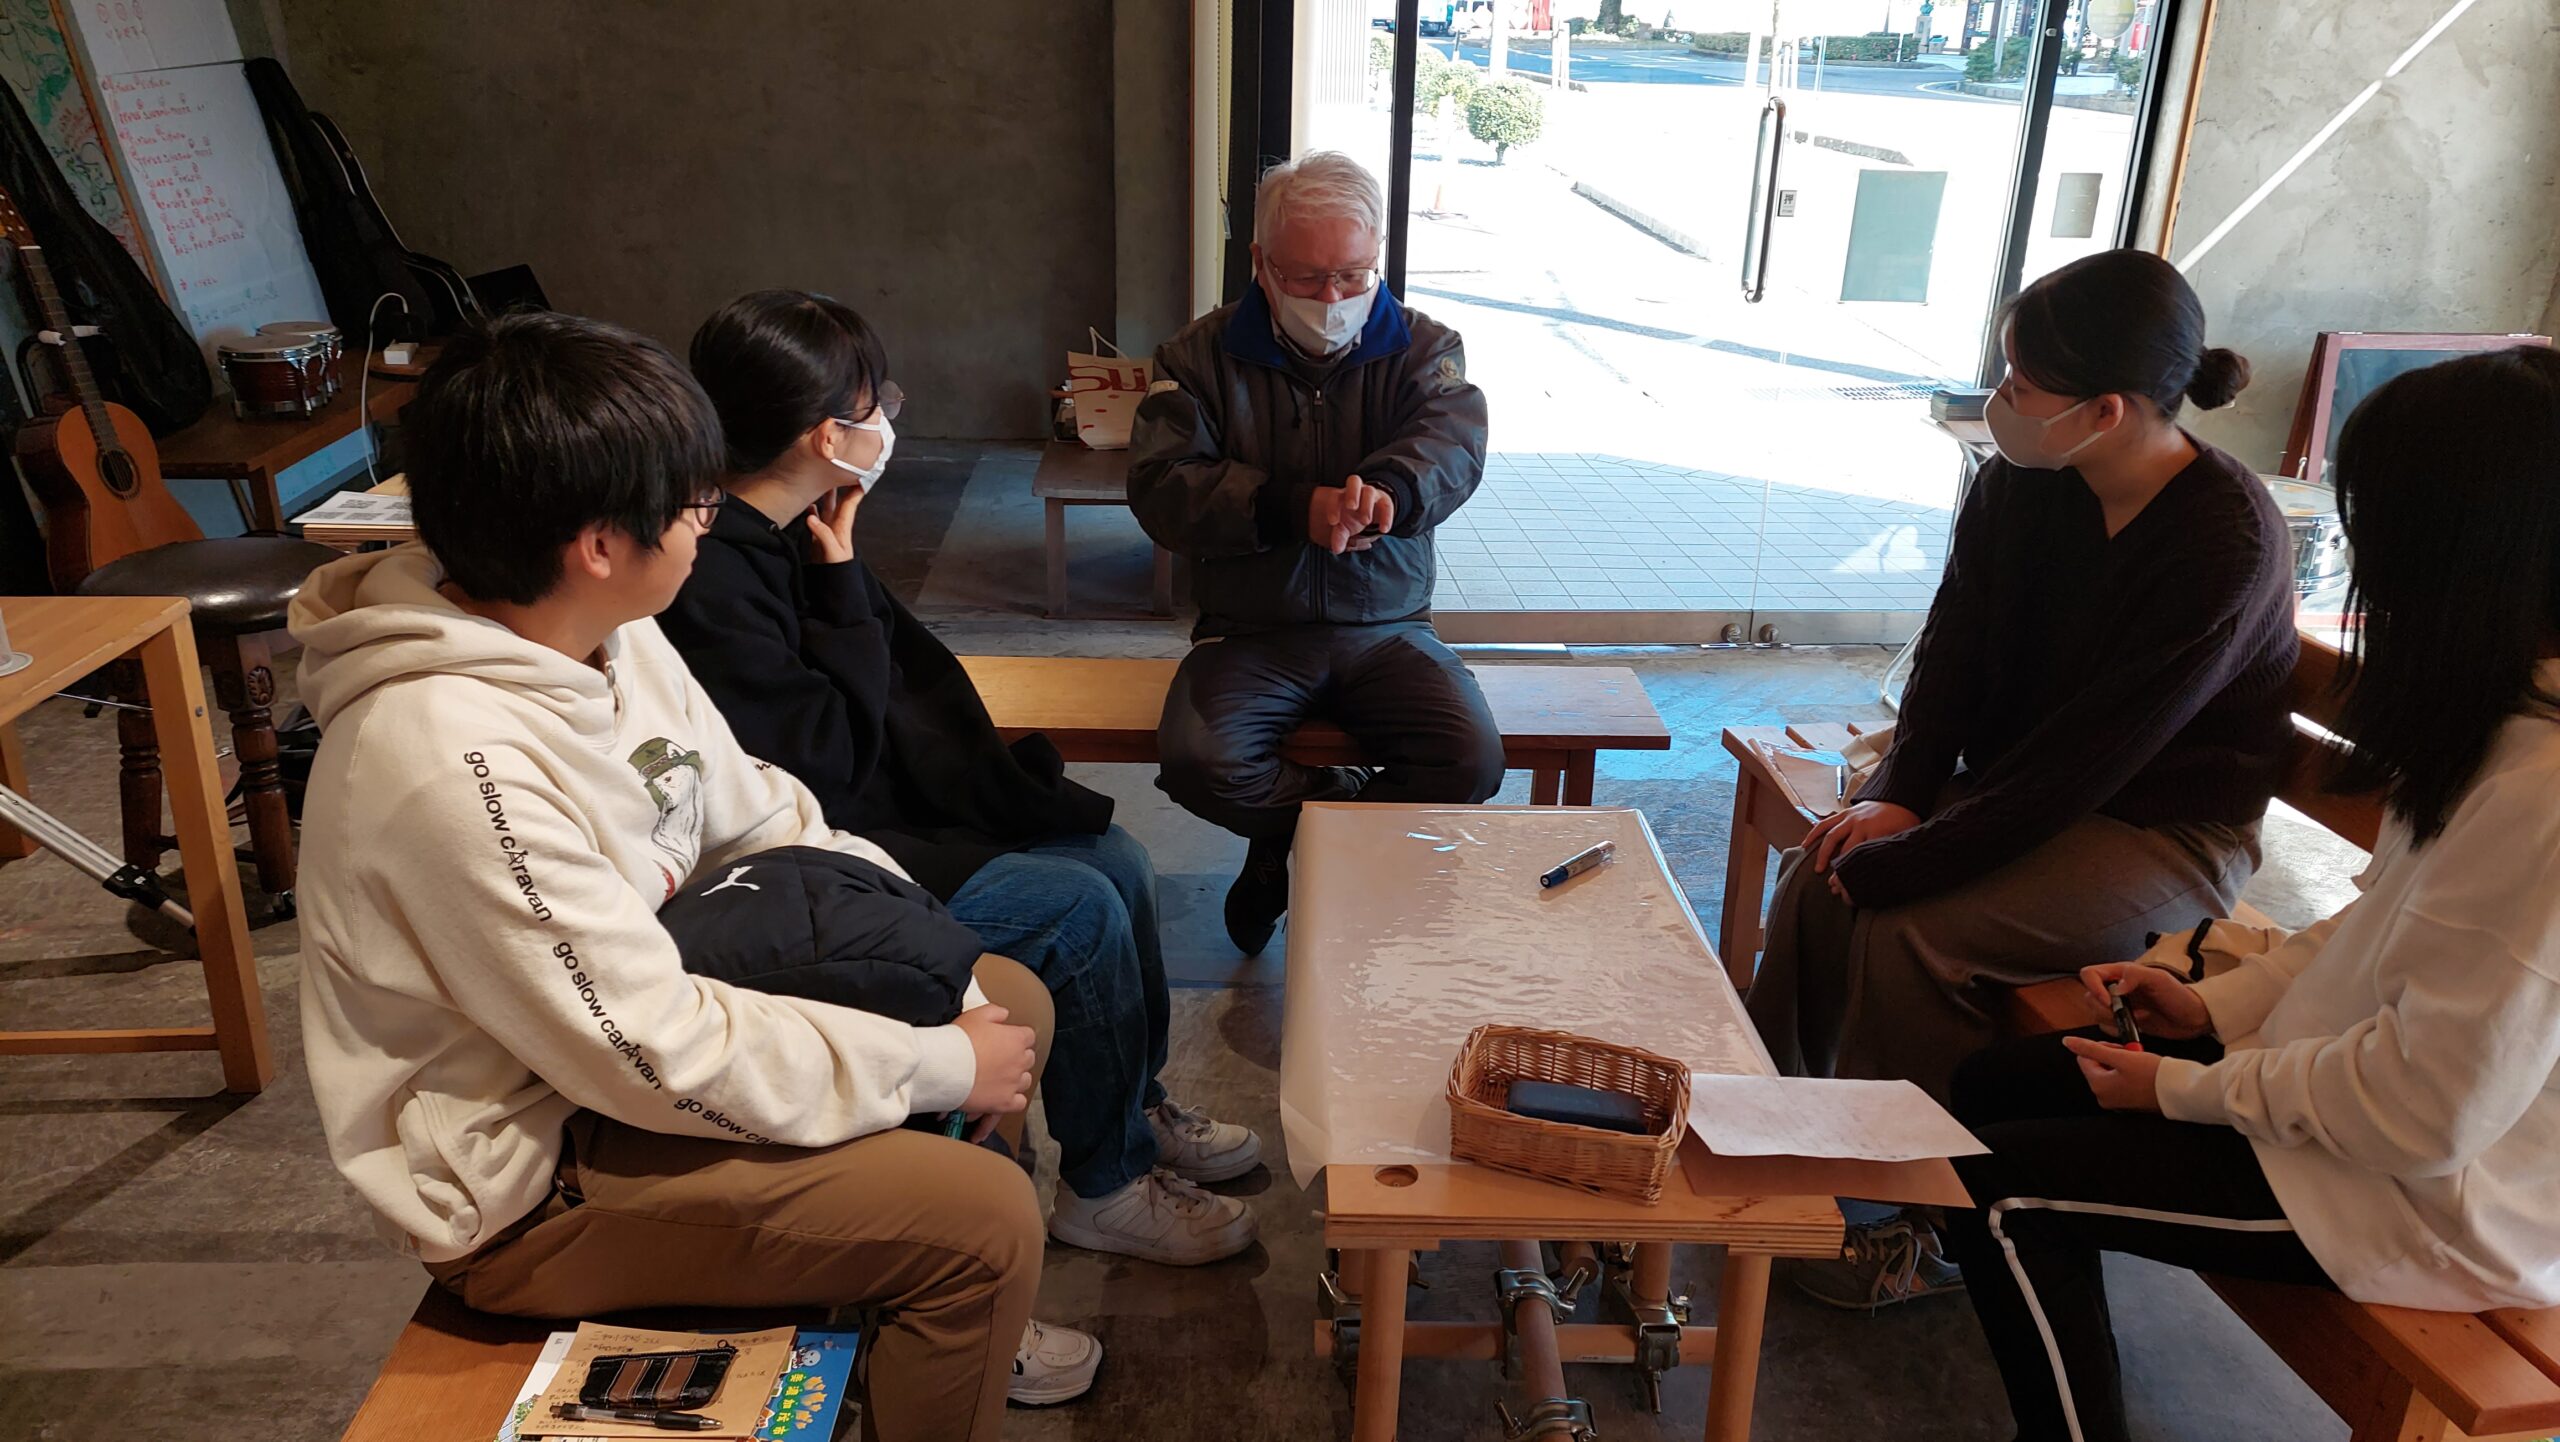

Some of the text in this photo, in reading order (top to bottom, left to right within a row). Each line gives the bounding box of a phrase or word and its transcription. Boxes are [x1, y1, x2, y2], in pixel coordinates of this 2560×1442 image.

[464, 751, 490, 778] go
[479, 781, 511, 832] slow
[553, 942, 579, 970] go
[572, 971, 606, 1018] slow
[674, 1098, 703, 1113] go
[702, 1110, 748, 1134] slow
